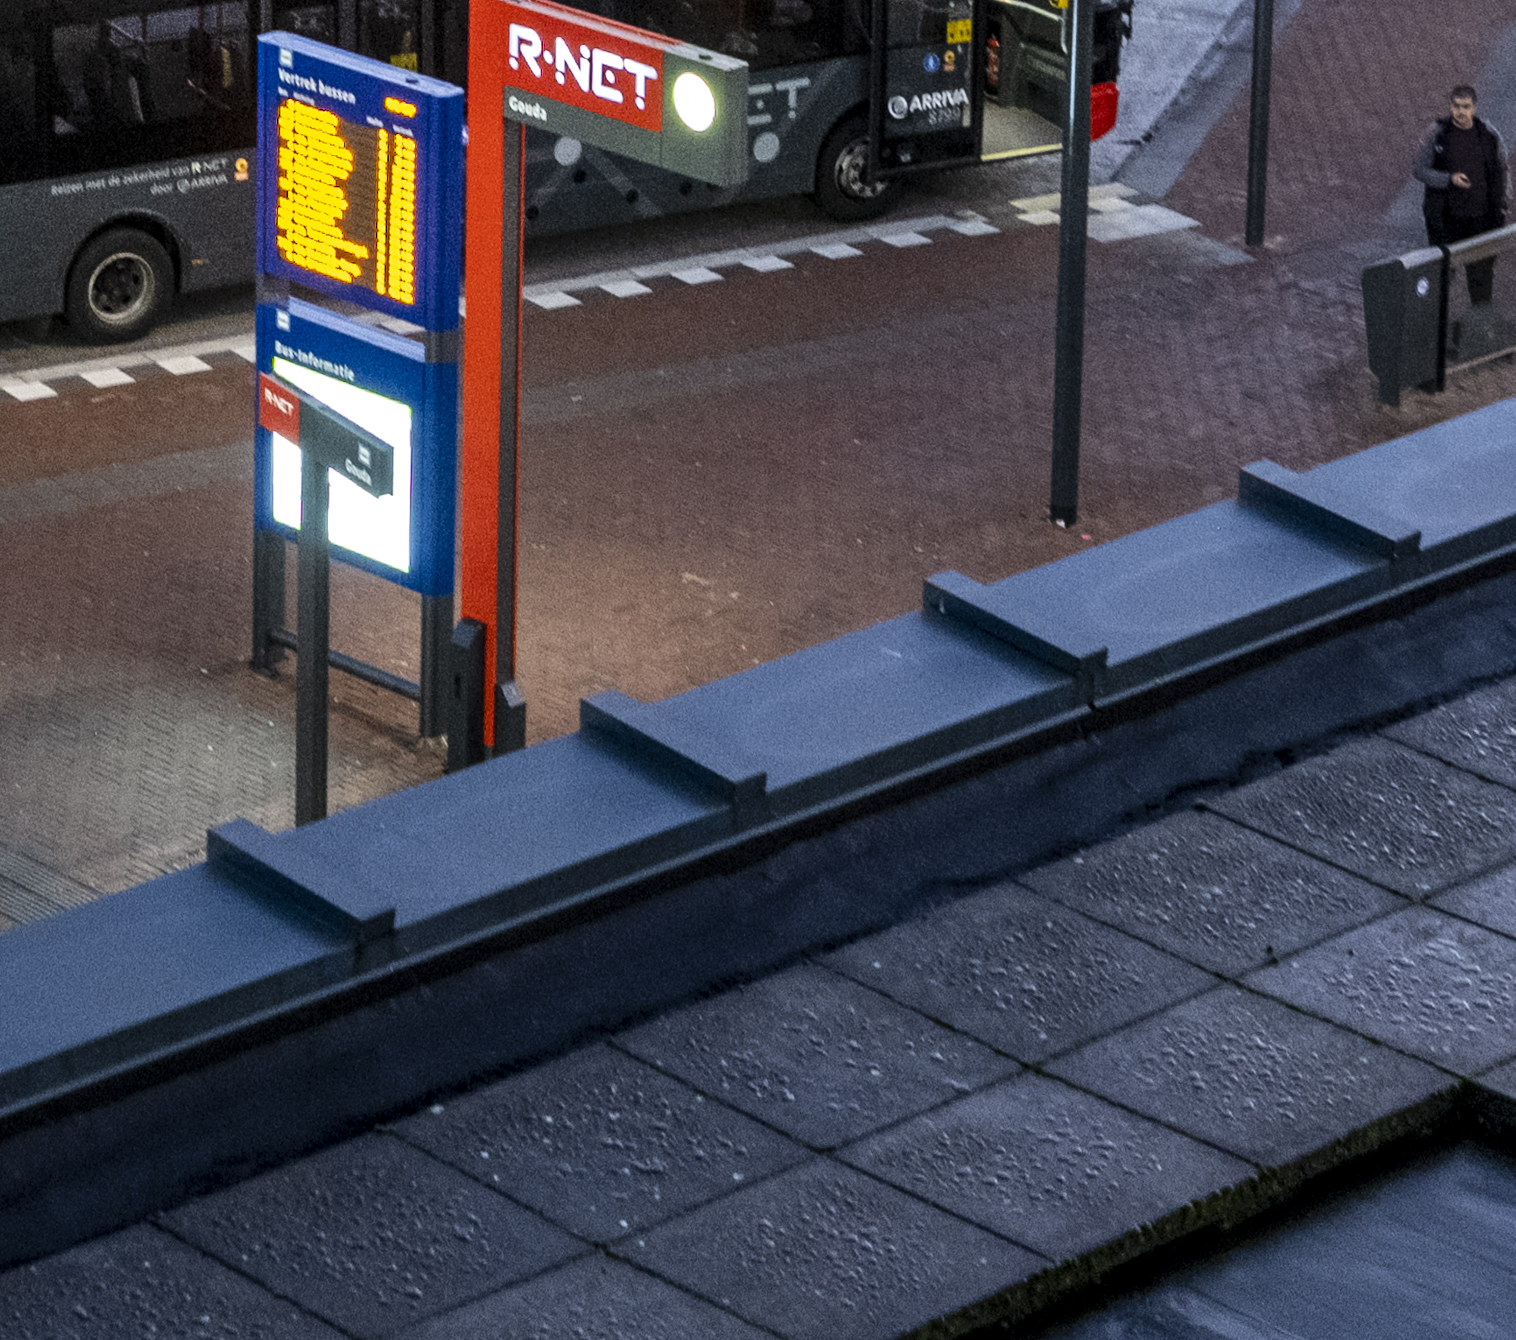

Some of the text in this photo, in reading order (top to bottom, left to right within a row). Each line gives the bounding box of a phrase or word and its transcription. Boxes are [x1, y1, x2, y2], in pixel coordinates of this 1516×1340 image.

[277, 67, 317, 94] Vertrek
[318, 79, 357, 106] bussen
[909, 87, 970, 113] ARRIVA
[508, 94, 548, 122] Gouda
